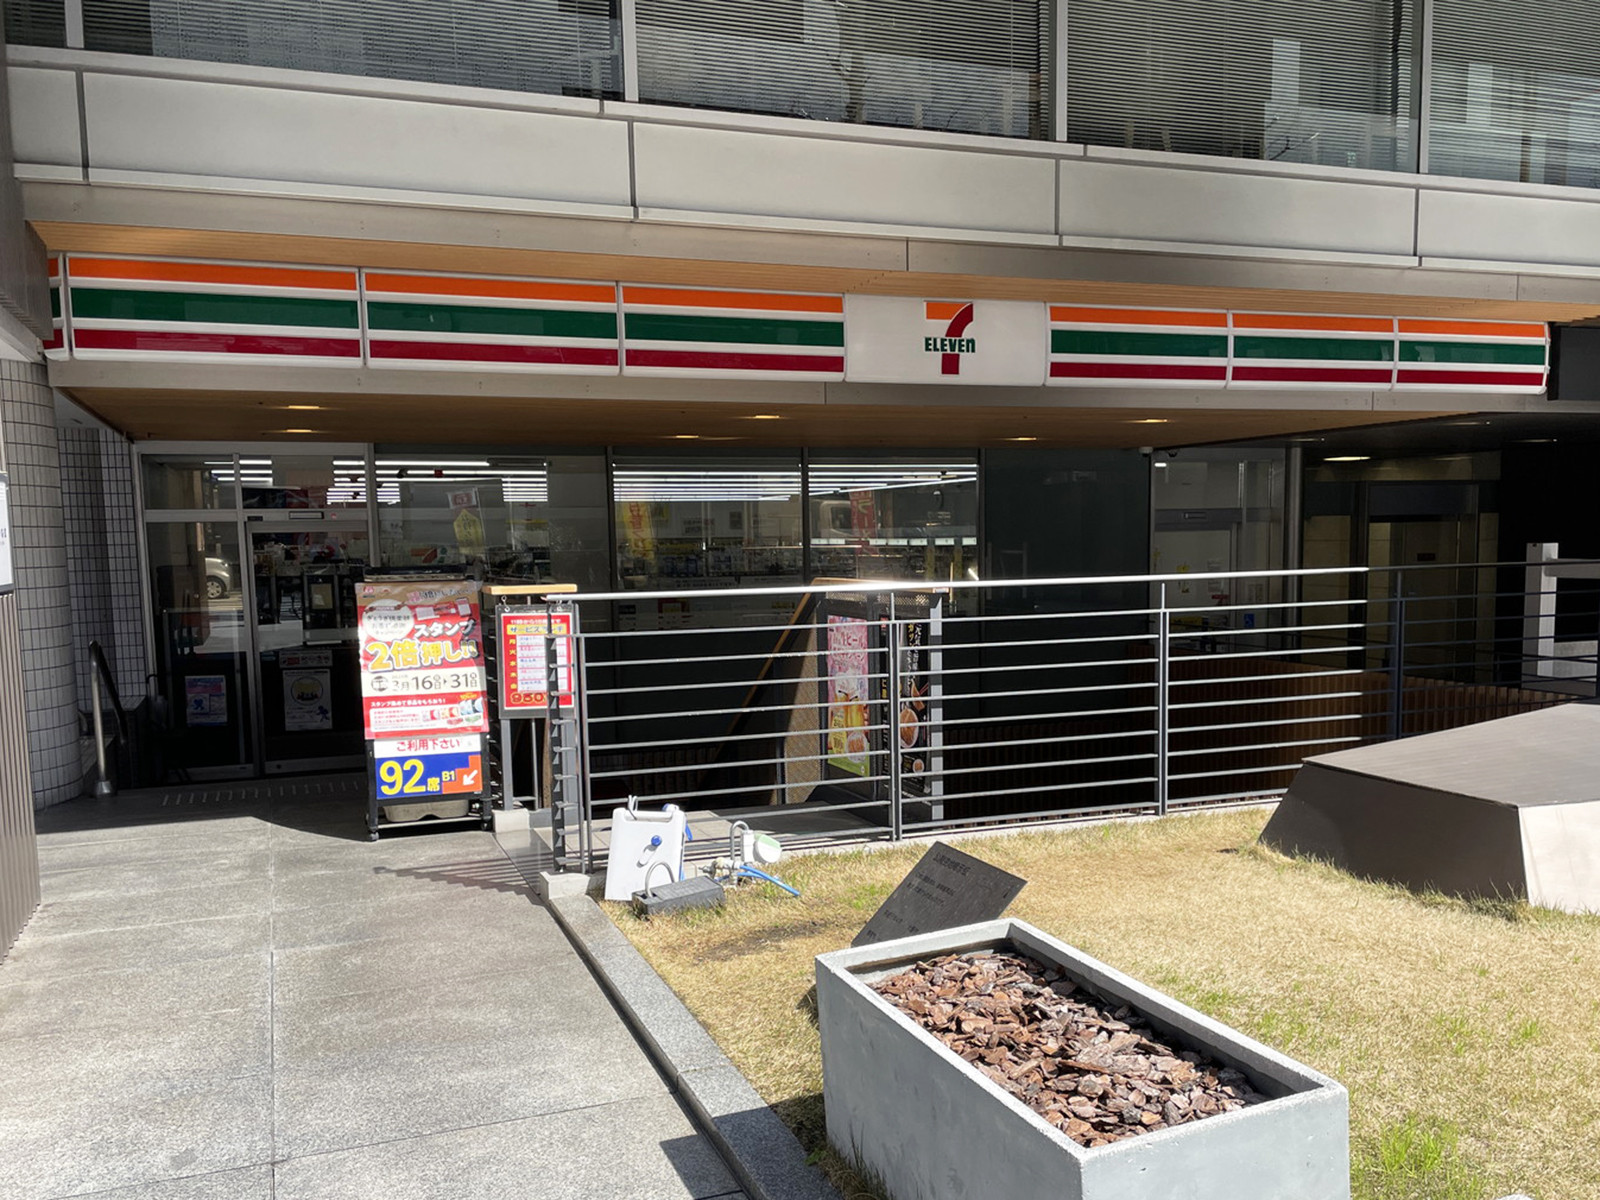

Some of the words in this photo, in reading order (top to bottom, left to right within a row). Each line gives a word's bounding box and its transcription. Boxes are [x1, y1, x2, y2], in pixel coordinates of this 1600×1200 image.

[414, 617, 476, 638] スタンプ
[397, 738, 460, 752] ご利用下さい
[442, 771, 455, 782] B1
